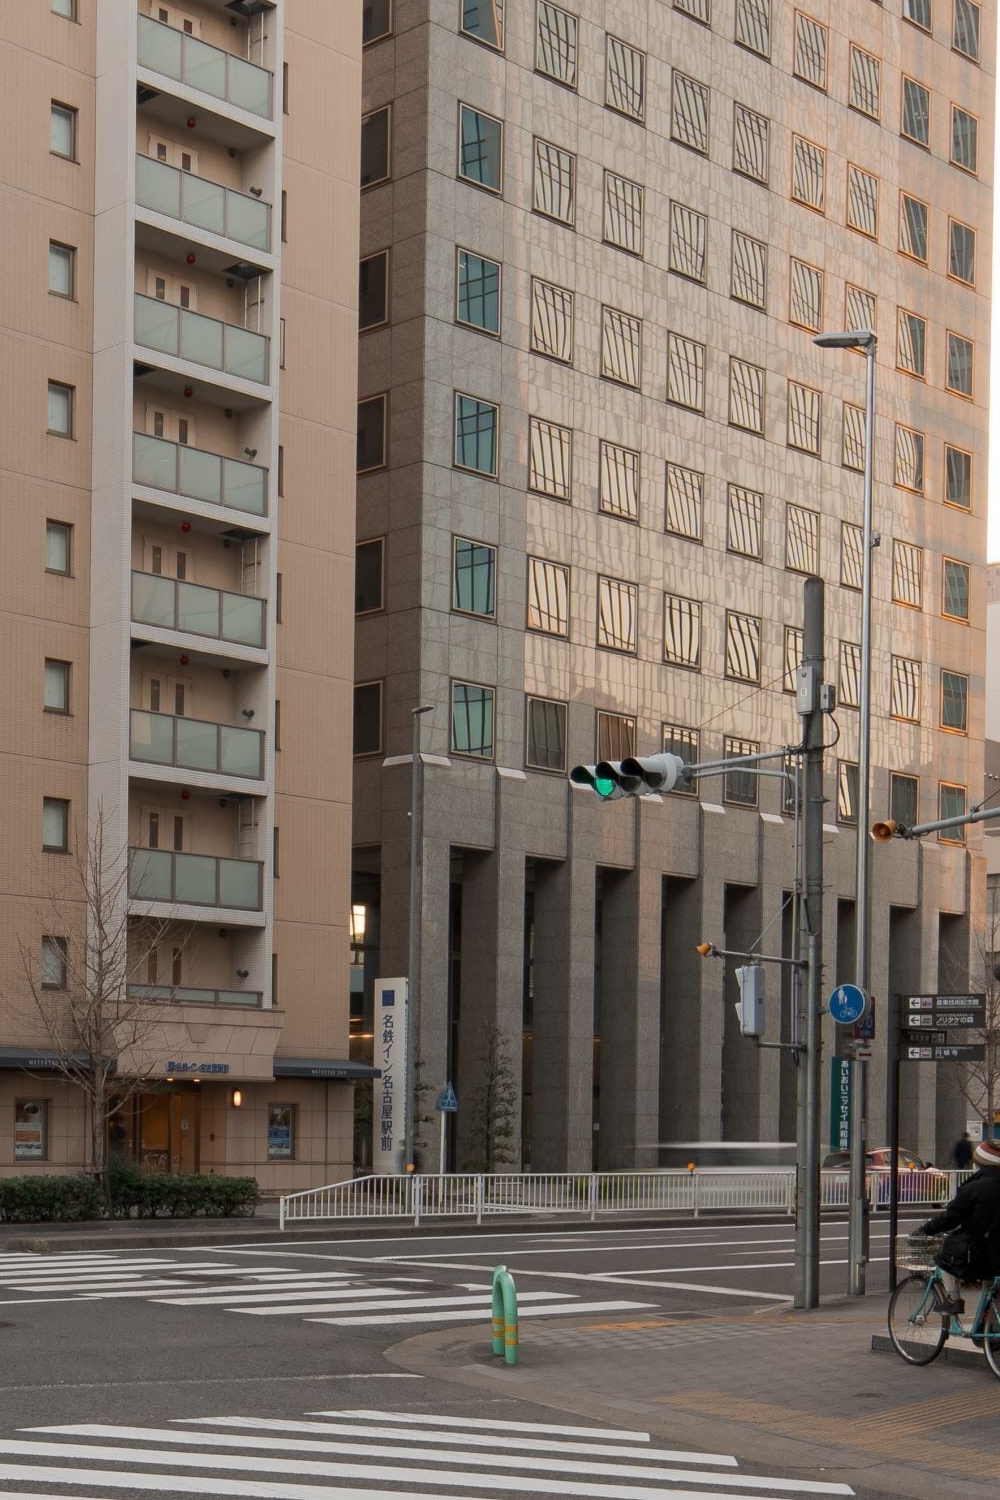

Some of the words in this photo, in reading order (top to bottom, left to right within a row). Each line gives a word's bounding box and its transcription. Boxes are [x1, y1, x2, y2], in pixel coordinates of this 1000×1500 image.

[381, 1014, 395, 1152] 名鉄イン名古屋駅前
